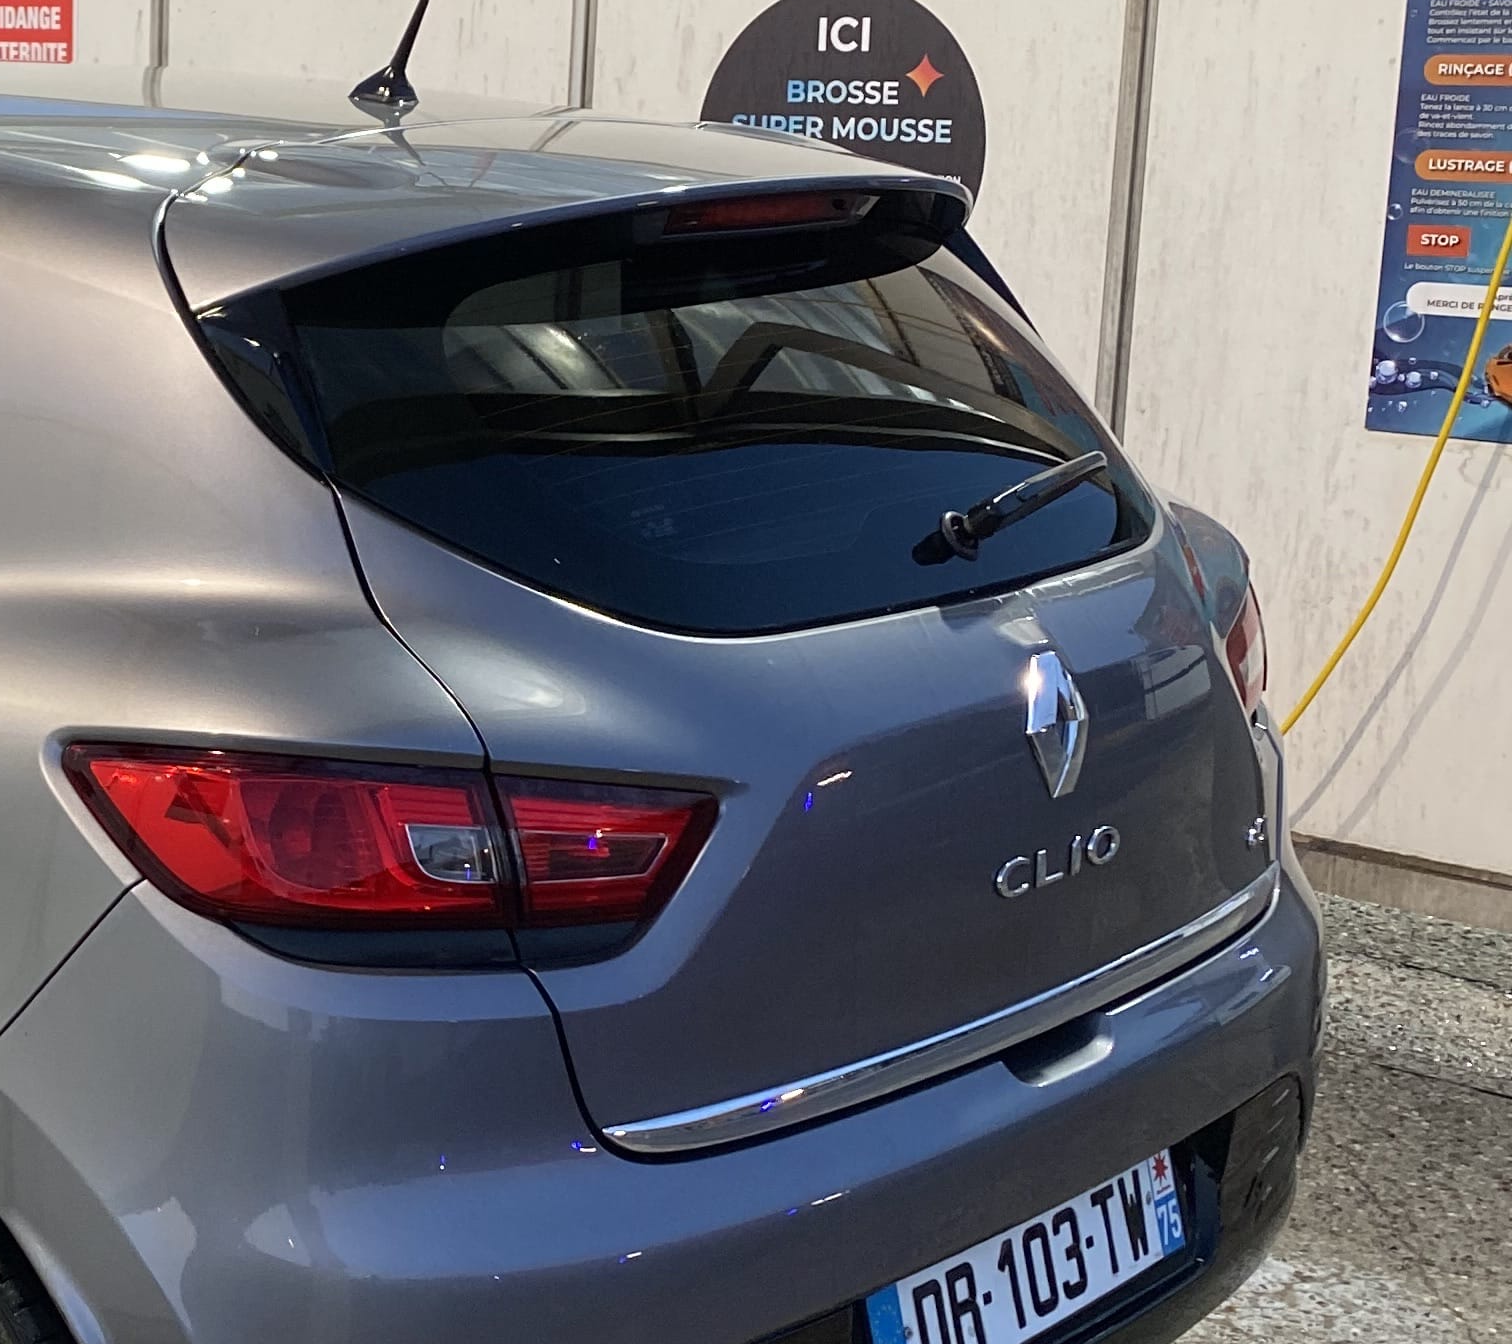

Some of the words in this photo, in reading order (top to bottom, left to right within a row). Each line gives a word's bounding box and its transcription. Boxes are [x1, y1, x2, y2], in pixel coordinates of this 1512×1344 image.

[817, 16, 872, 53] ICI
[1437, 63, 1505, 79] RINÇAGE
[787, 79, 900, 106] BROSSE
[832, 116, 953, 144] MOUSSE
[1428, 157, 1505, 173] LUSTRAGE
[1420, 233, 1460, 247] STOP
[1403, 262, 1415, 270] Le
[1415, 262, 1444, 272] bouton
[1444, 264, 1467, 273] STOP
[1426, 299, 1459, 309] MERCI
[1461, 301, 1475, 310] DE
[996, 825, 1121, 899] CLIO
[1156, 1198, 1182, 1246] 75
